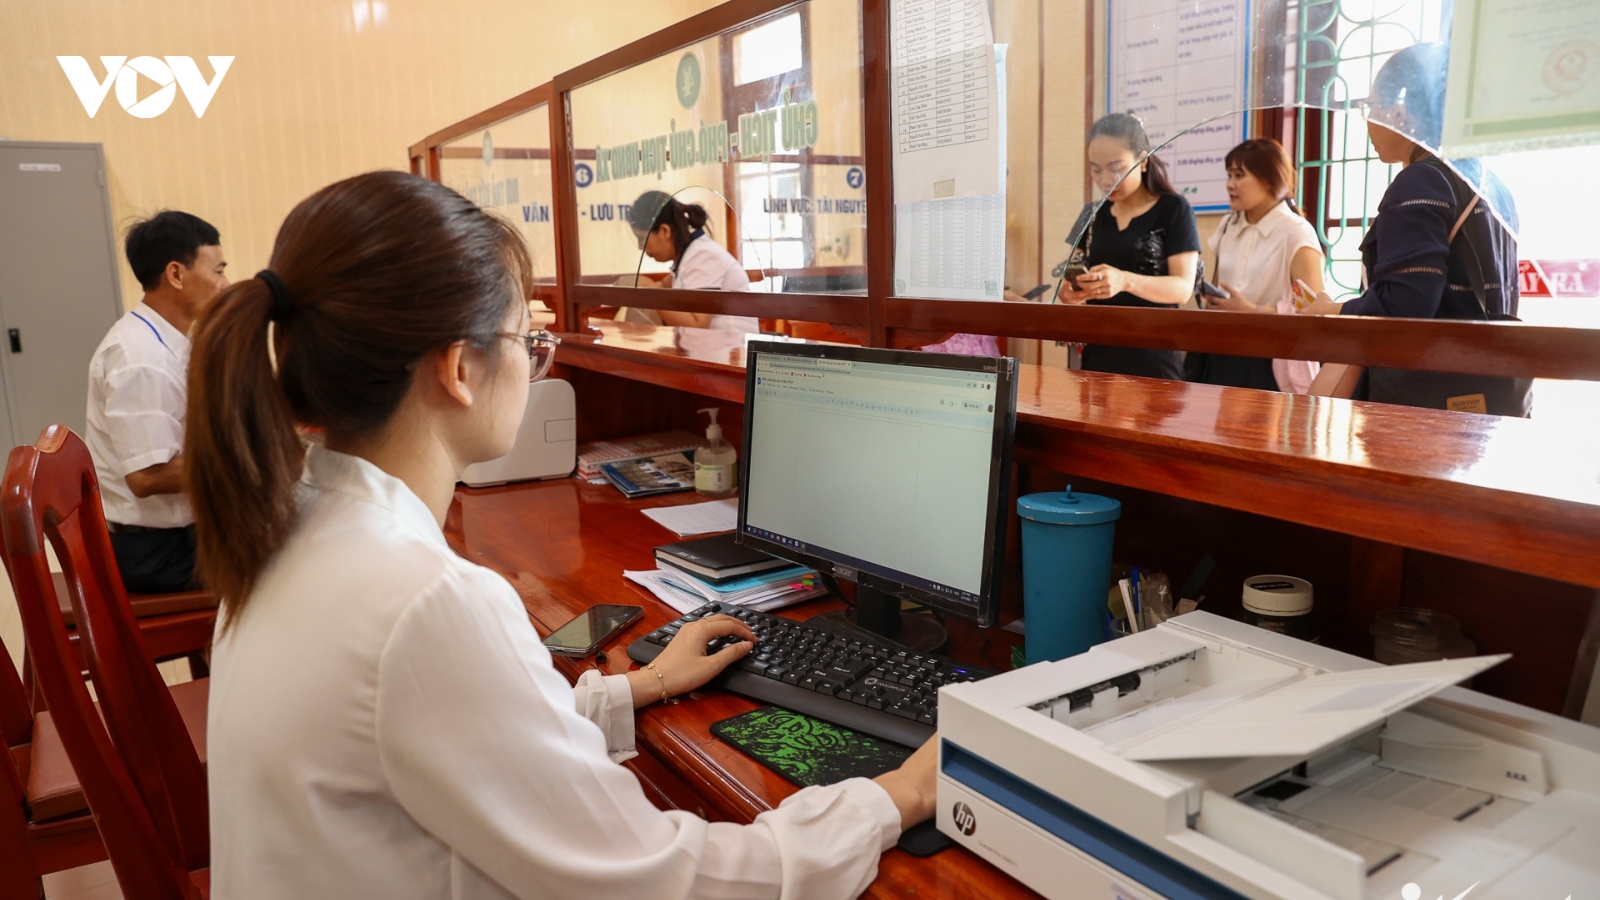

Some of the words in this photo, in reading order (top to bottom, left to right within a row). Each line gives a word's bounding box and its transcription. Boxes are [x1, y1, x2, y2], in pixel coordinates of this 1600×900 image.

[522, 201, 550, 222] VĂN
[590, 203, 613, 221] LƯU
[817, 195, 833, 213] TÀI
[836, 567, 853, 577] acer
[955, 802, 974, 835] hp
